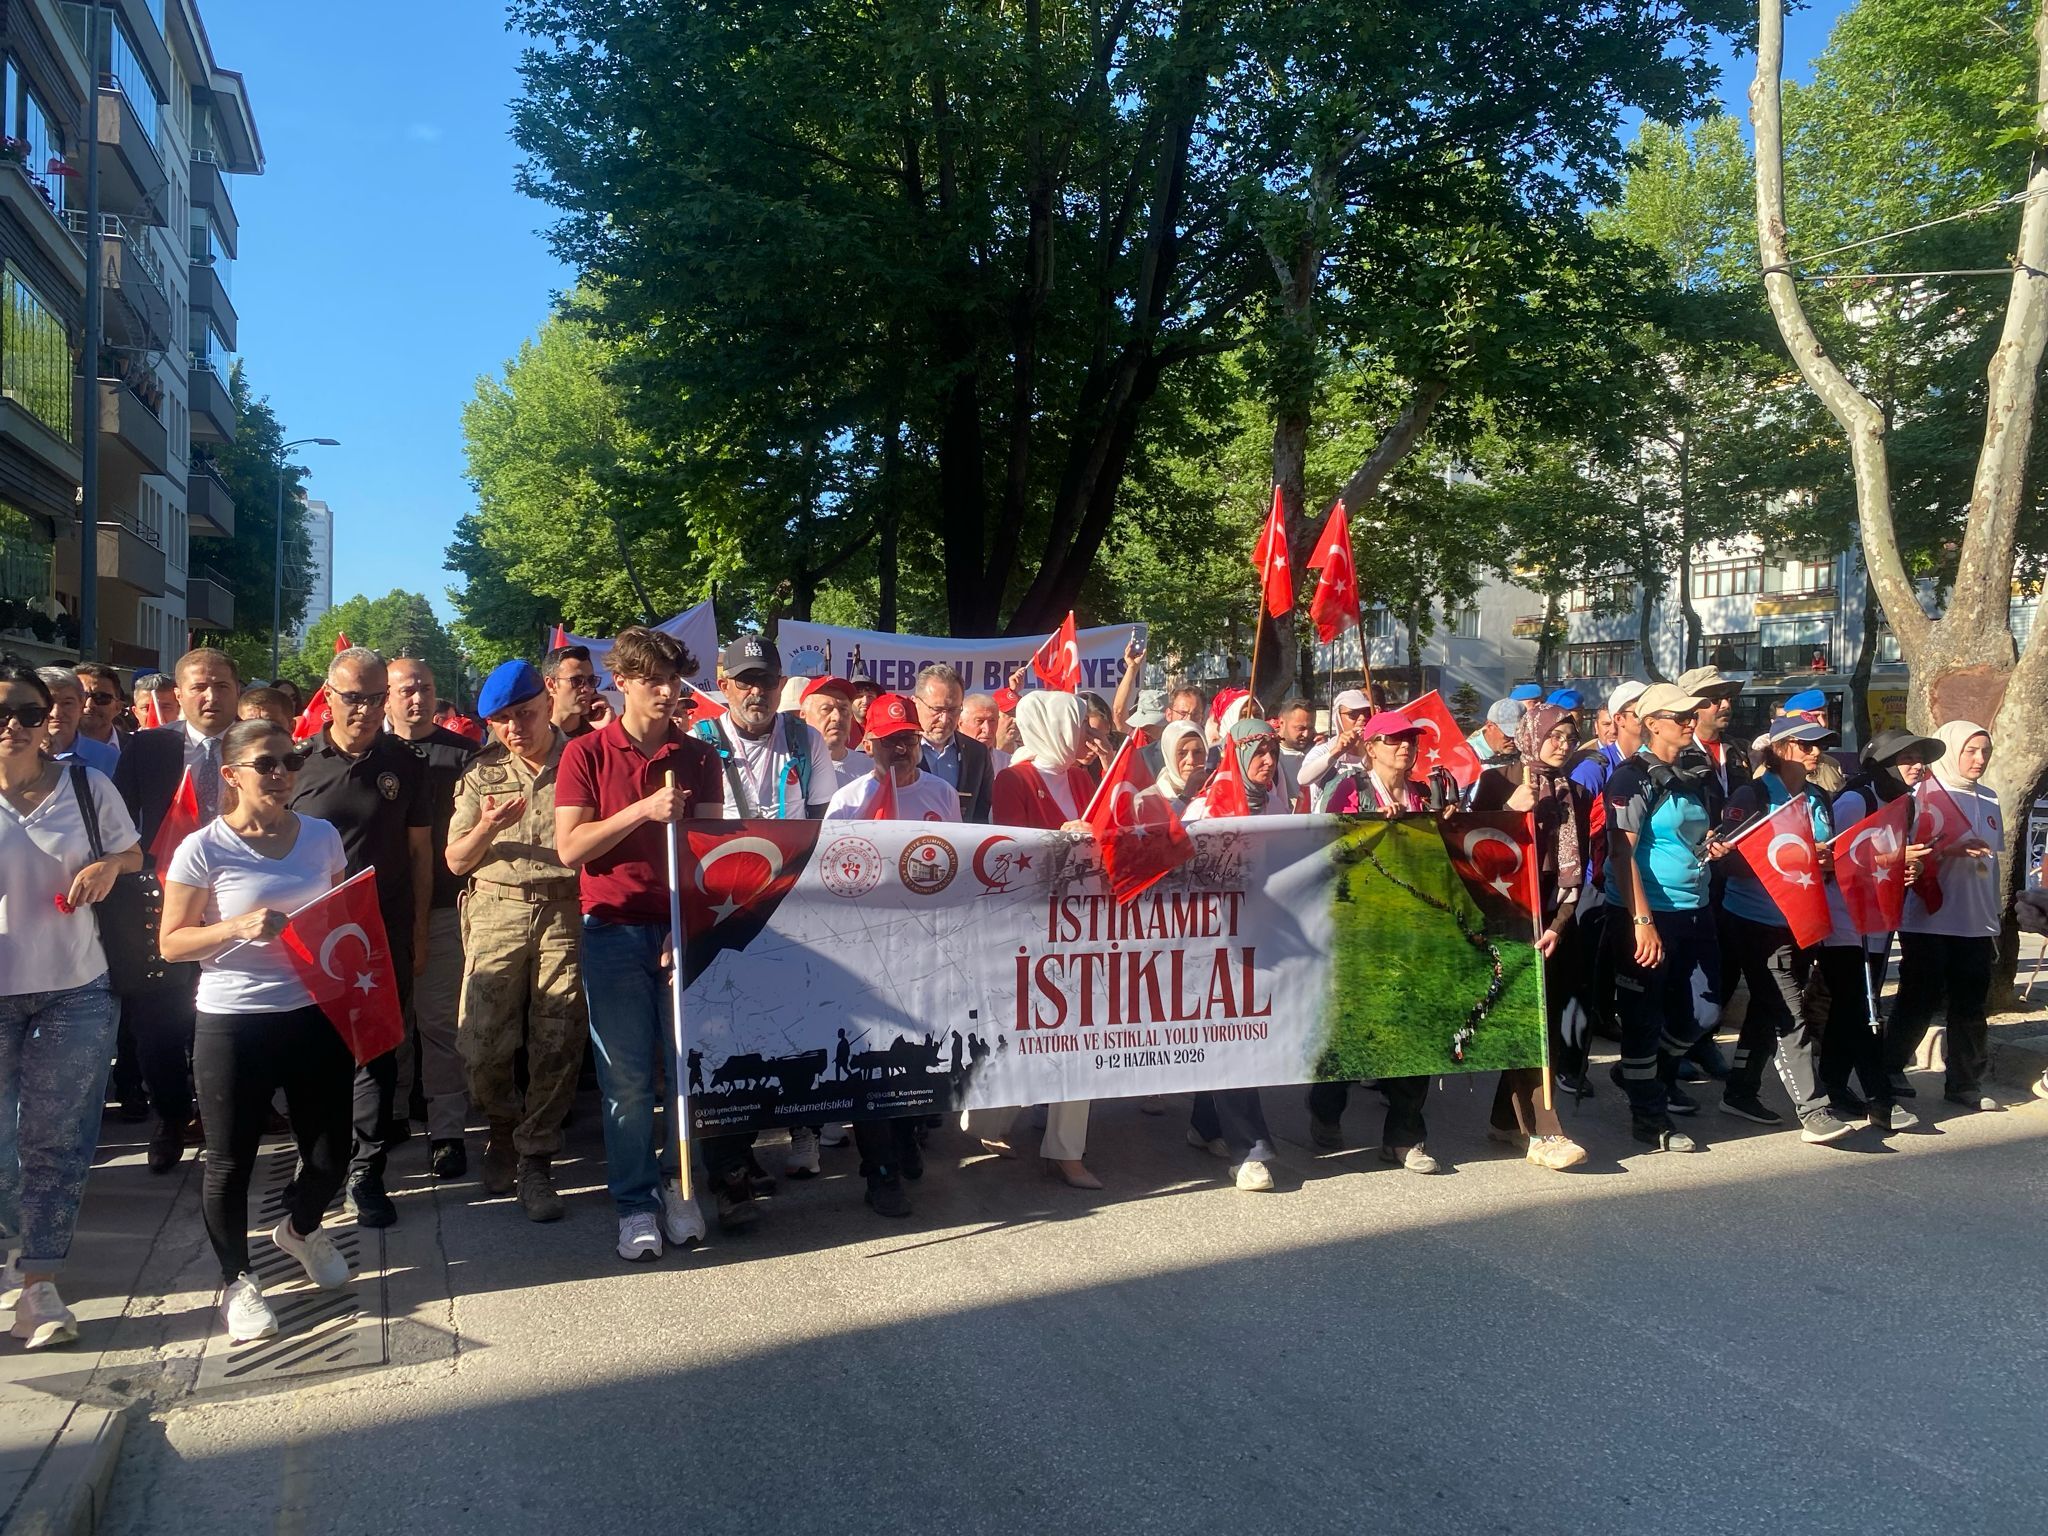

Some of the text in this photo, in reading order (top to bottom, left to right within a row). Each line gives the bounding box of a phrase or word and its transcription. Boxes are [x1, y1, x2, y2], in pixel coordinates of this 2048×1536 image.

[846, 652, 973, 691] İNEBU
[1048, 888, 1246, 943] İSTİKAMET
[1015, 942, 1272, 1031] İSTİKLAL
[1018, 1021, 1268, 1055] ATATÜRK VE İSTİKLAL YOLU YÜRÜYÜŞÜ
[1095, 1048, 1205, 1069] 9-12 HAZİRAN 2026
